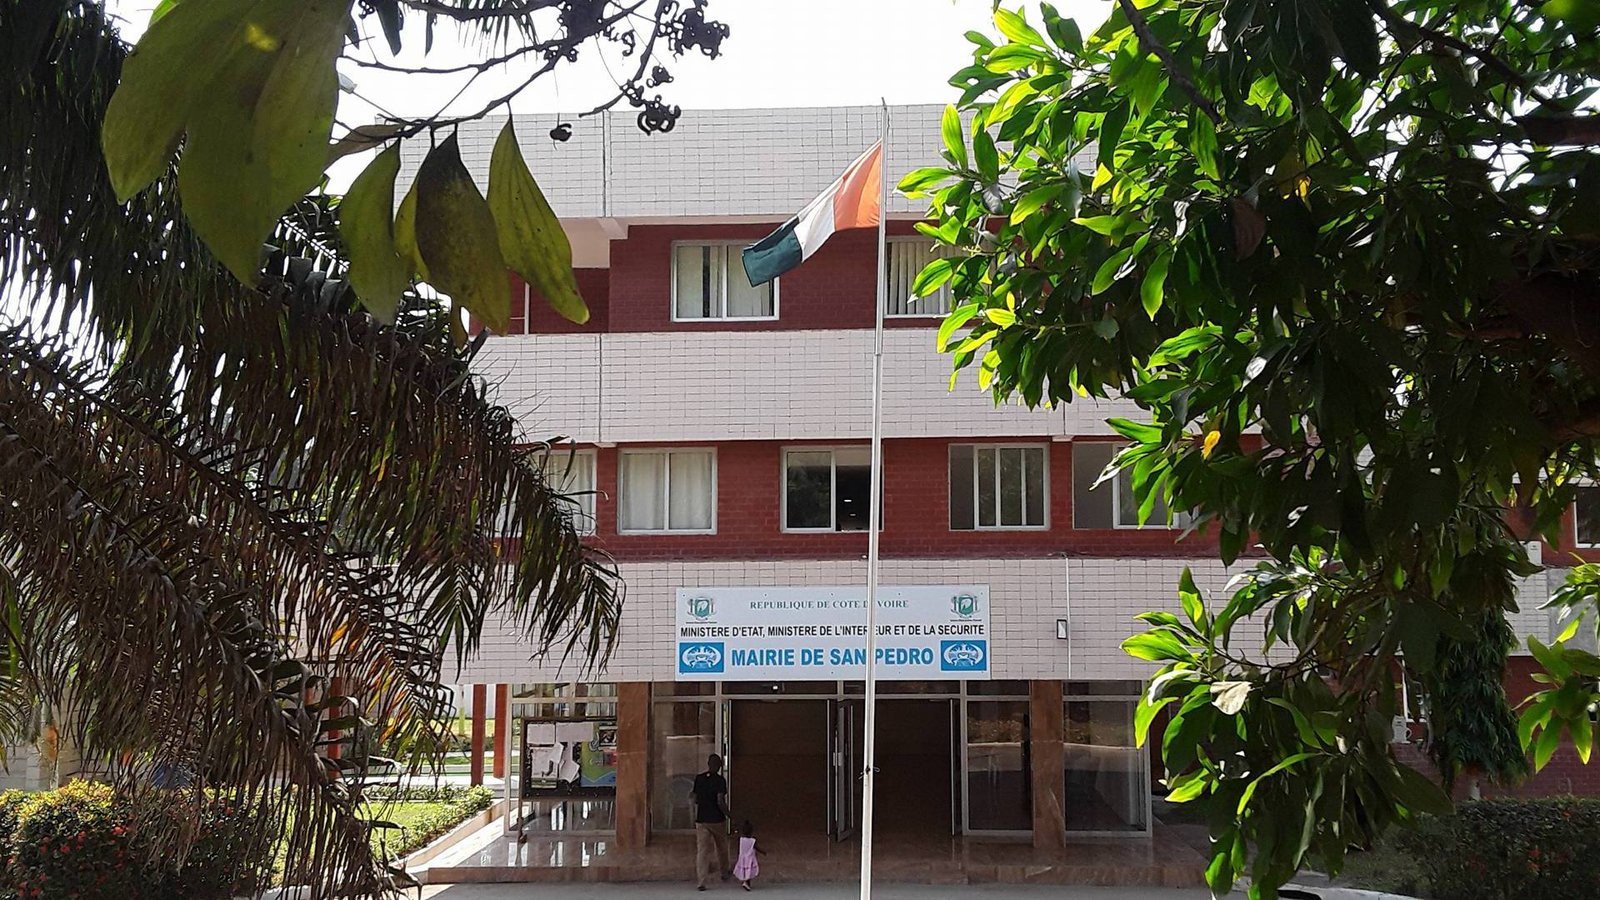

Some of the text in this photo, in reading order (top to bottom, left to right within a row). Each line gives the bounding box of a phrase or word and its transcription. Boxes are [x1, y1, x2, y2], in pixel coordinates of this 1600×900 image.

[750, 601, 815, 609] REPUBLIQUE
[680, 626, 730, 637] MINISTERE
[732, 626, 765, 638] D'ETAT,
[767, 625, 817, 636] MINISTERE
[819, 625, 832, 636] DE
[894, 625, 906, 635] ET
[908, 625, 921, 635] DE
[924, 625, 936, 635] LA
[938, 625, 984, 635] SECURITE
[731, 648, 934, 666] MAIRIE DE SAN PEDRO
